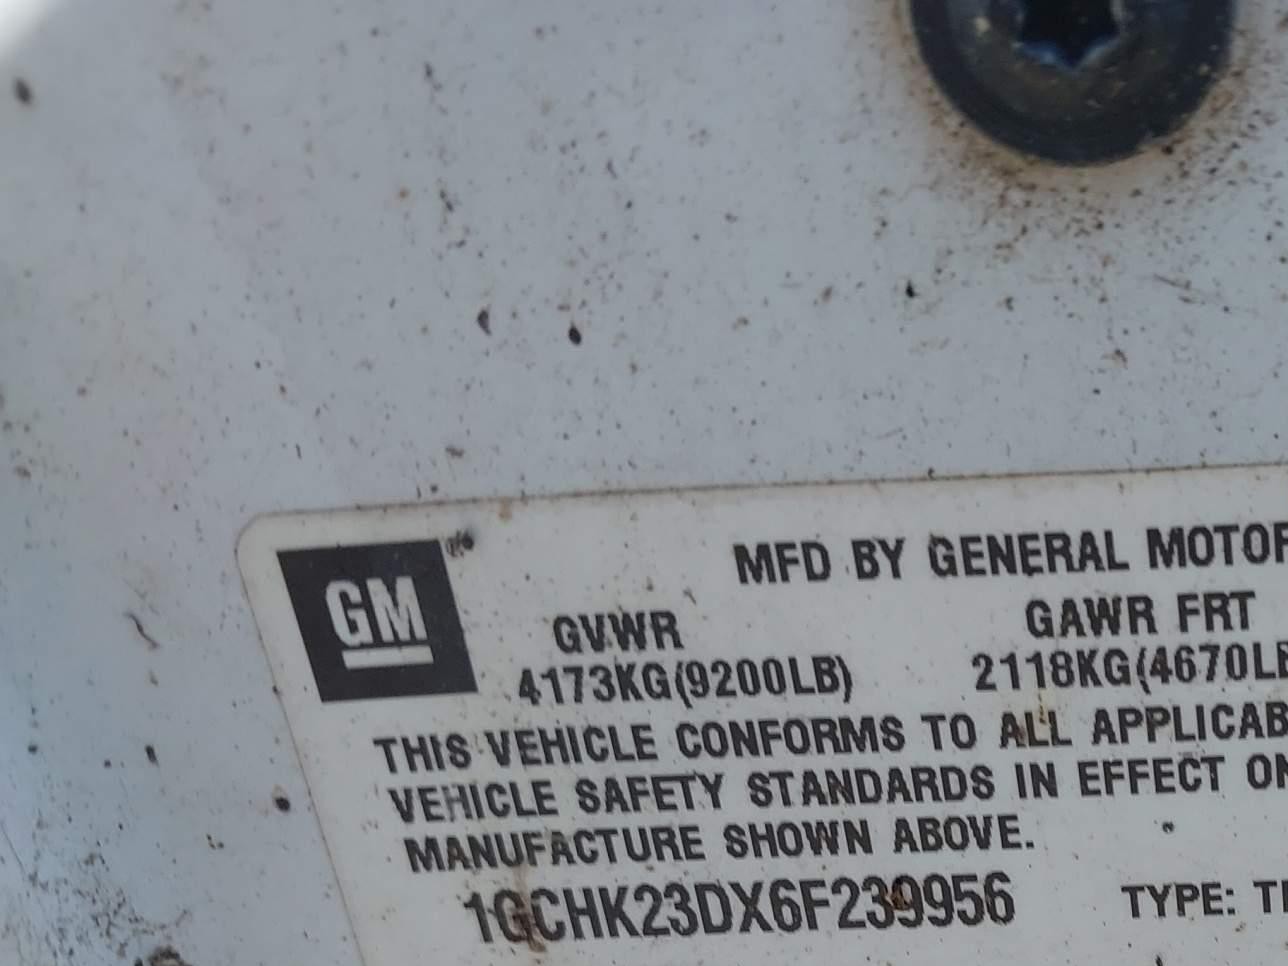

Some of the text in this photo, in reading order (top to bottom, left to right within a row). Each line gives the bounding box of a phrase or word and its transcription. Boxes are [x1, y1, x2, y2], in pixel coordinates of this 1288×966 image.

[733, 541, 831, 584] MFD
[851, 538, 905, 580] BY
[928, 530, 1130, 578] GENERAL
[325, 575, 428, 650] GM
[553, 611, 684, 654] GVWR
[1025, 591, 1255, 638] GAWR FRT
[519, 656, 853, 709] 4173KG(9200LB)
[373, 733, 471, 773] THIS
[484, 724, 658, 767] VEHICLE
[676, 716, 905, 758] CONFORMS
[921, 714, 977, 751] TO
[1000, 706, 1072, 748] ALL
[388, 780, 558, 823] VEHICLE
[575, 771, 723, 814] SAFETY
[747, 765, 995, 807] STANDARDS
[1015, 762, 1058, 799] IN
[1077, 753, 1225, 796] EFFECT
[404, 814, 1034, 873] MANUFACTURE SHOWN ABOVE.
[463, 871, 1015, 945] 1GCHK23DX6F239956
[1121, 882, 1235, 918] TYPE:
